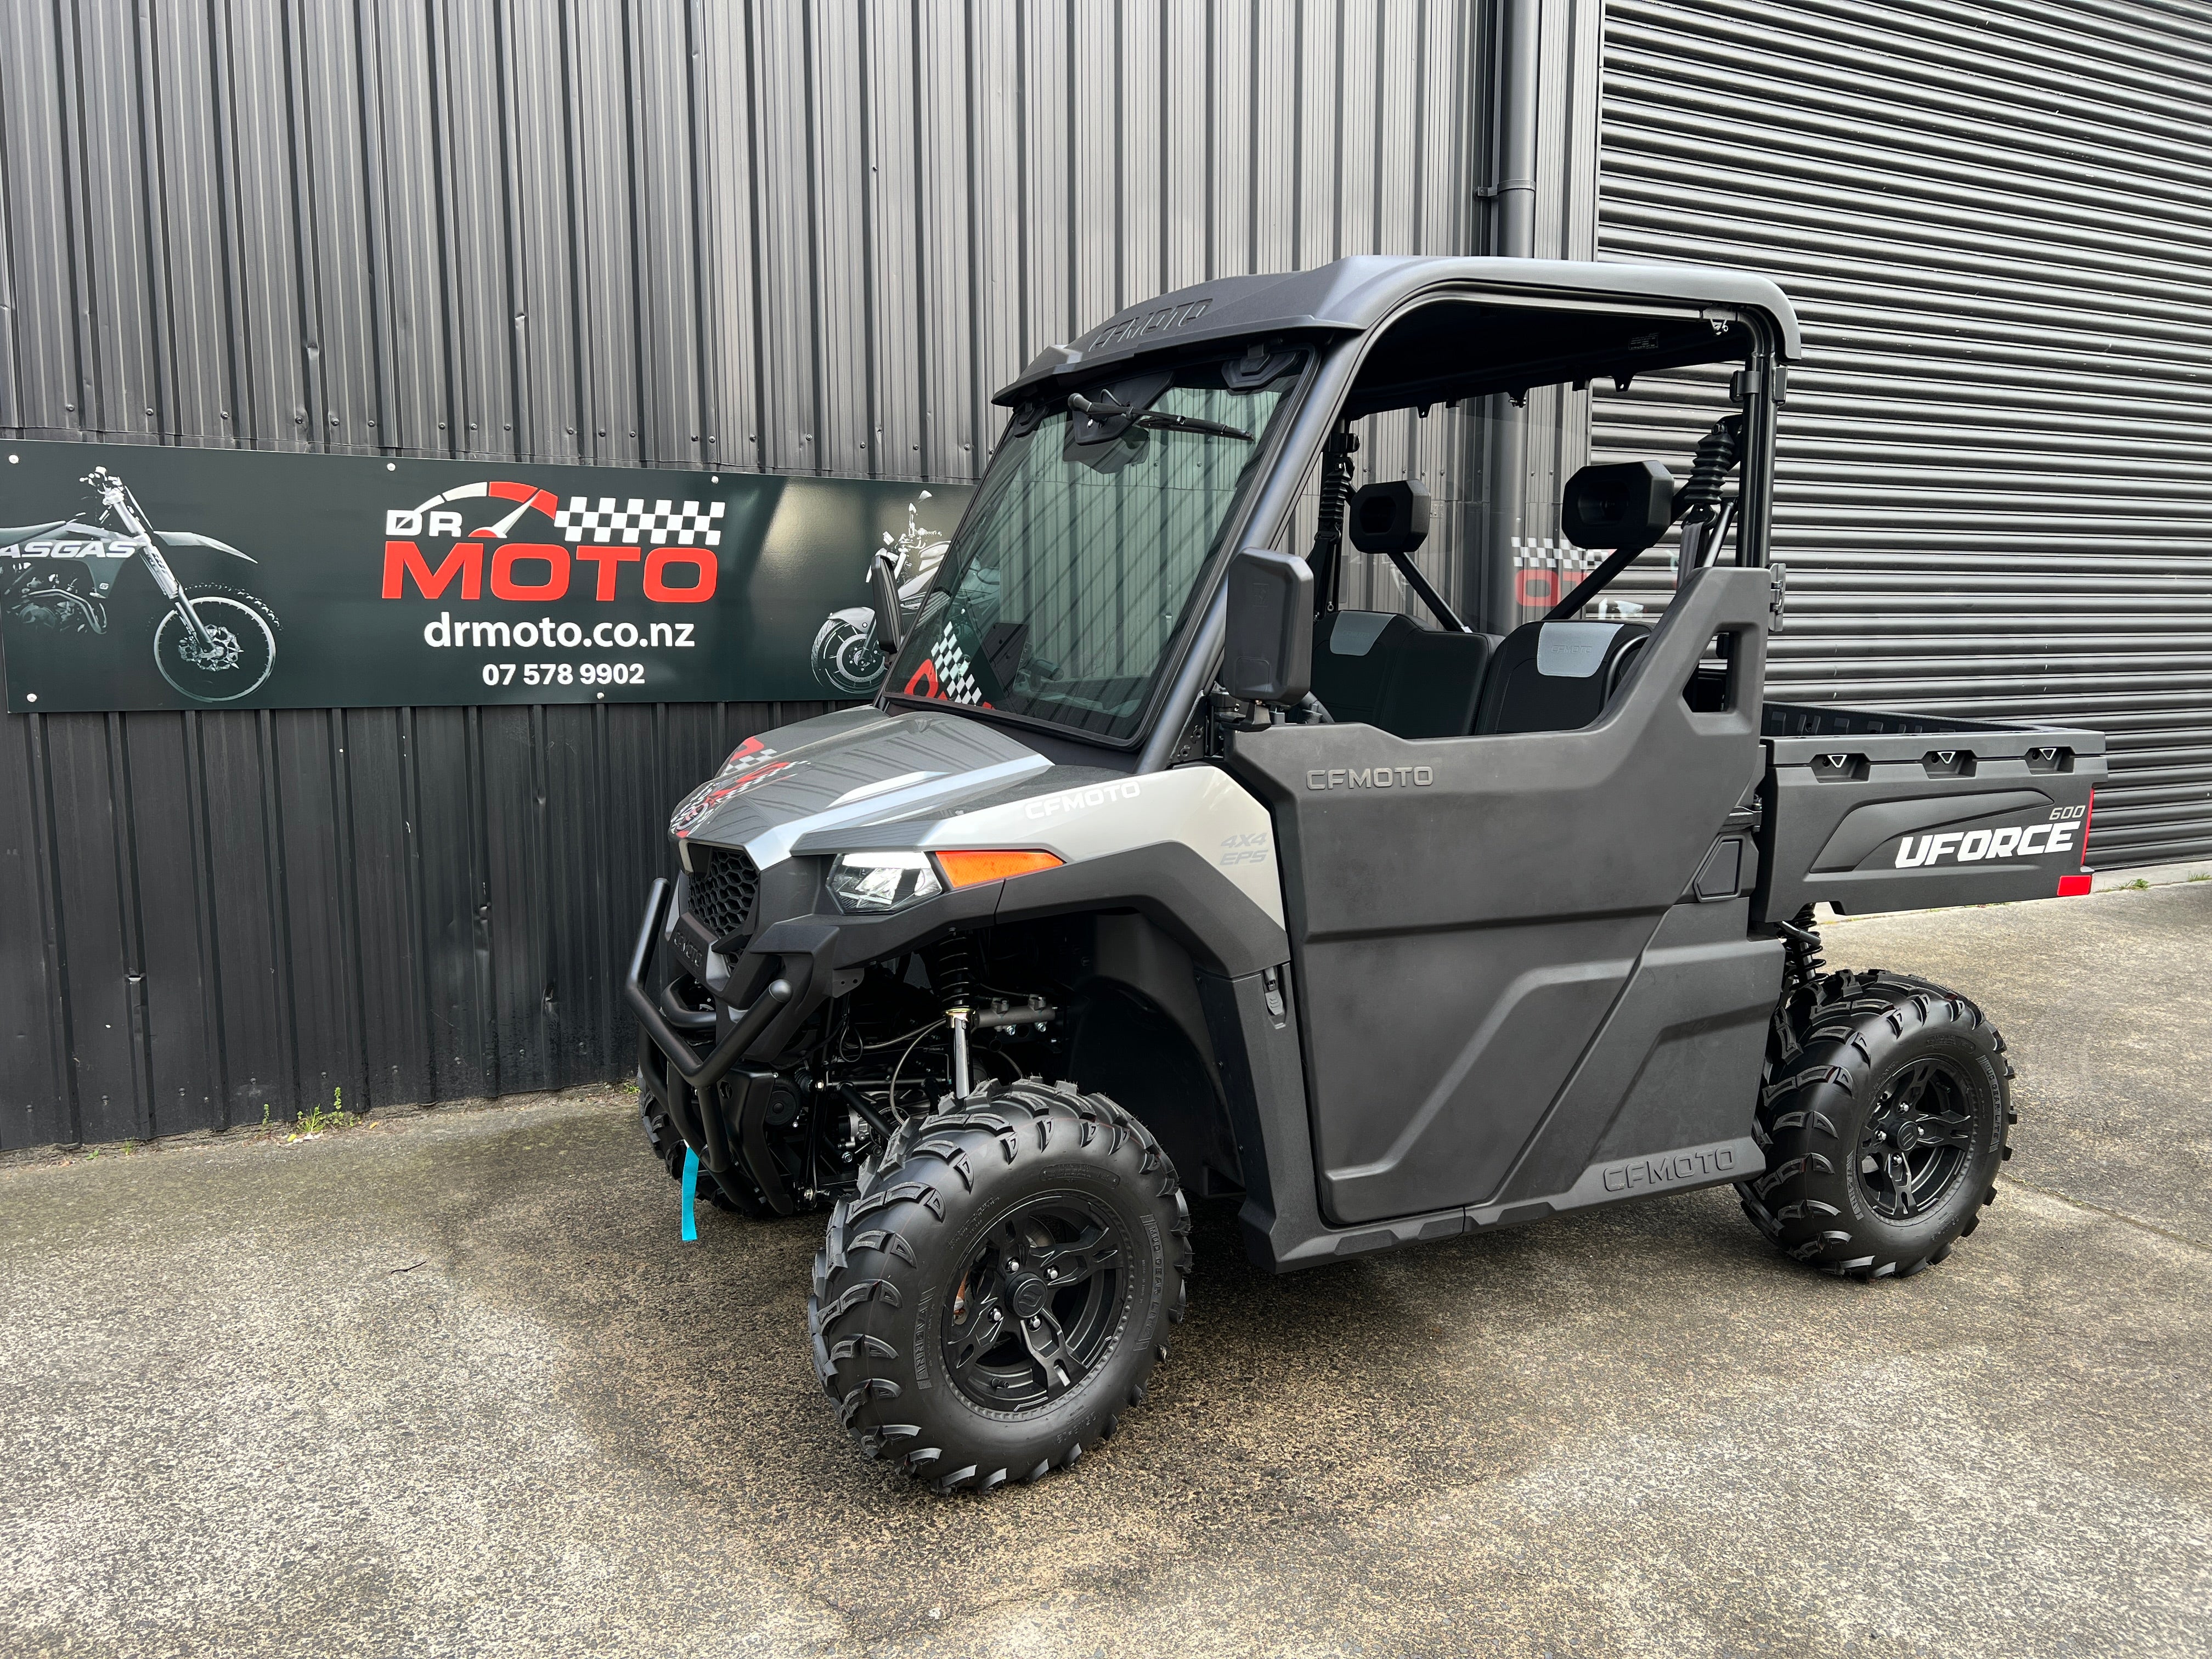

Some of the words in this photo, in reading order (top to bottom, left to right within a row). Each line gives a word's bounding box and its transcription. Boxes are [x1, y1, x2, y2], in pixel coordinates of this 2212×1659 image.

[1088, 298, 1213, 352] CFMOTO
[386, 510, 462, 537] DR
[382, 541, 718, 602] MOTO
[424, 612, 695, 647] drmoto.co.nz
[483, 664, 516, 686] 07
[523, 663, 573, 685] 578
[580, 663, 645, 685] 9902
[1306, 766, 1434, 791] CFMOTO
[1024, 781, 1141, 820] CFMOTO
[2049, 805, 2086, 821] 600
[1220, 832, 1267, 849] 4X4
[1895, 821, 2081, 869] UFORCE
[1219, 849, 1268, 866] EPS
[1984, 1063, 1995, 1080] MUD
[1603, 1146, 1735, 1192] CFMOTO
[1148, 1227, 1161, 1252] MUD
[1154, 1257, 1163, 1295] GEAR
